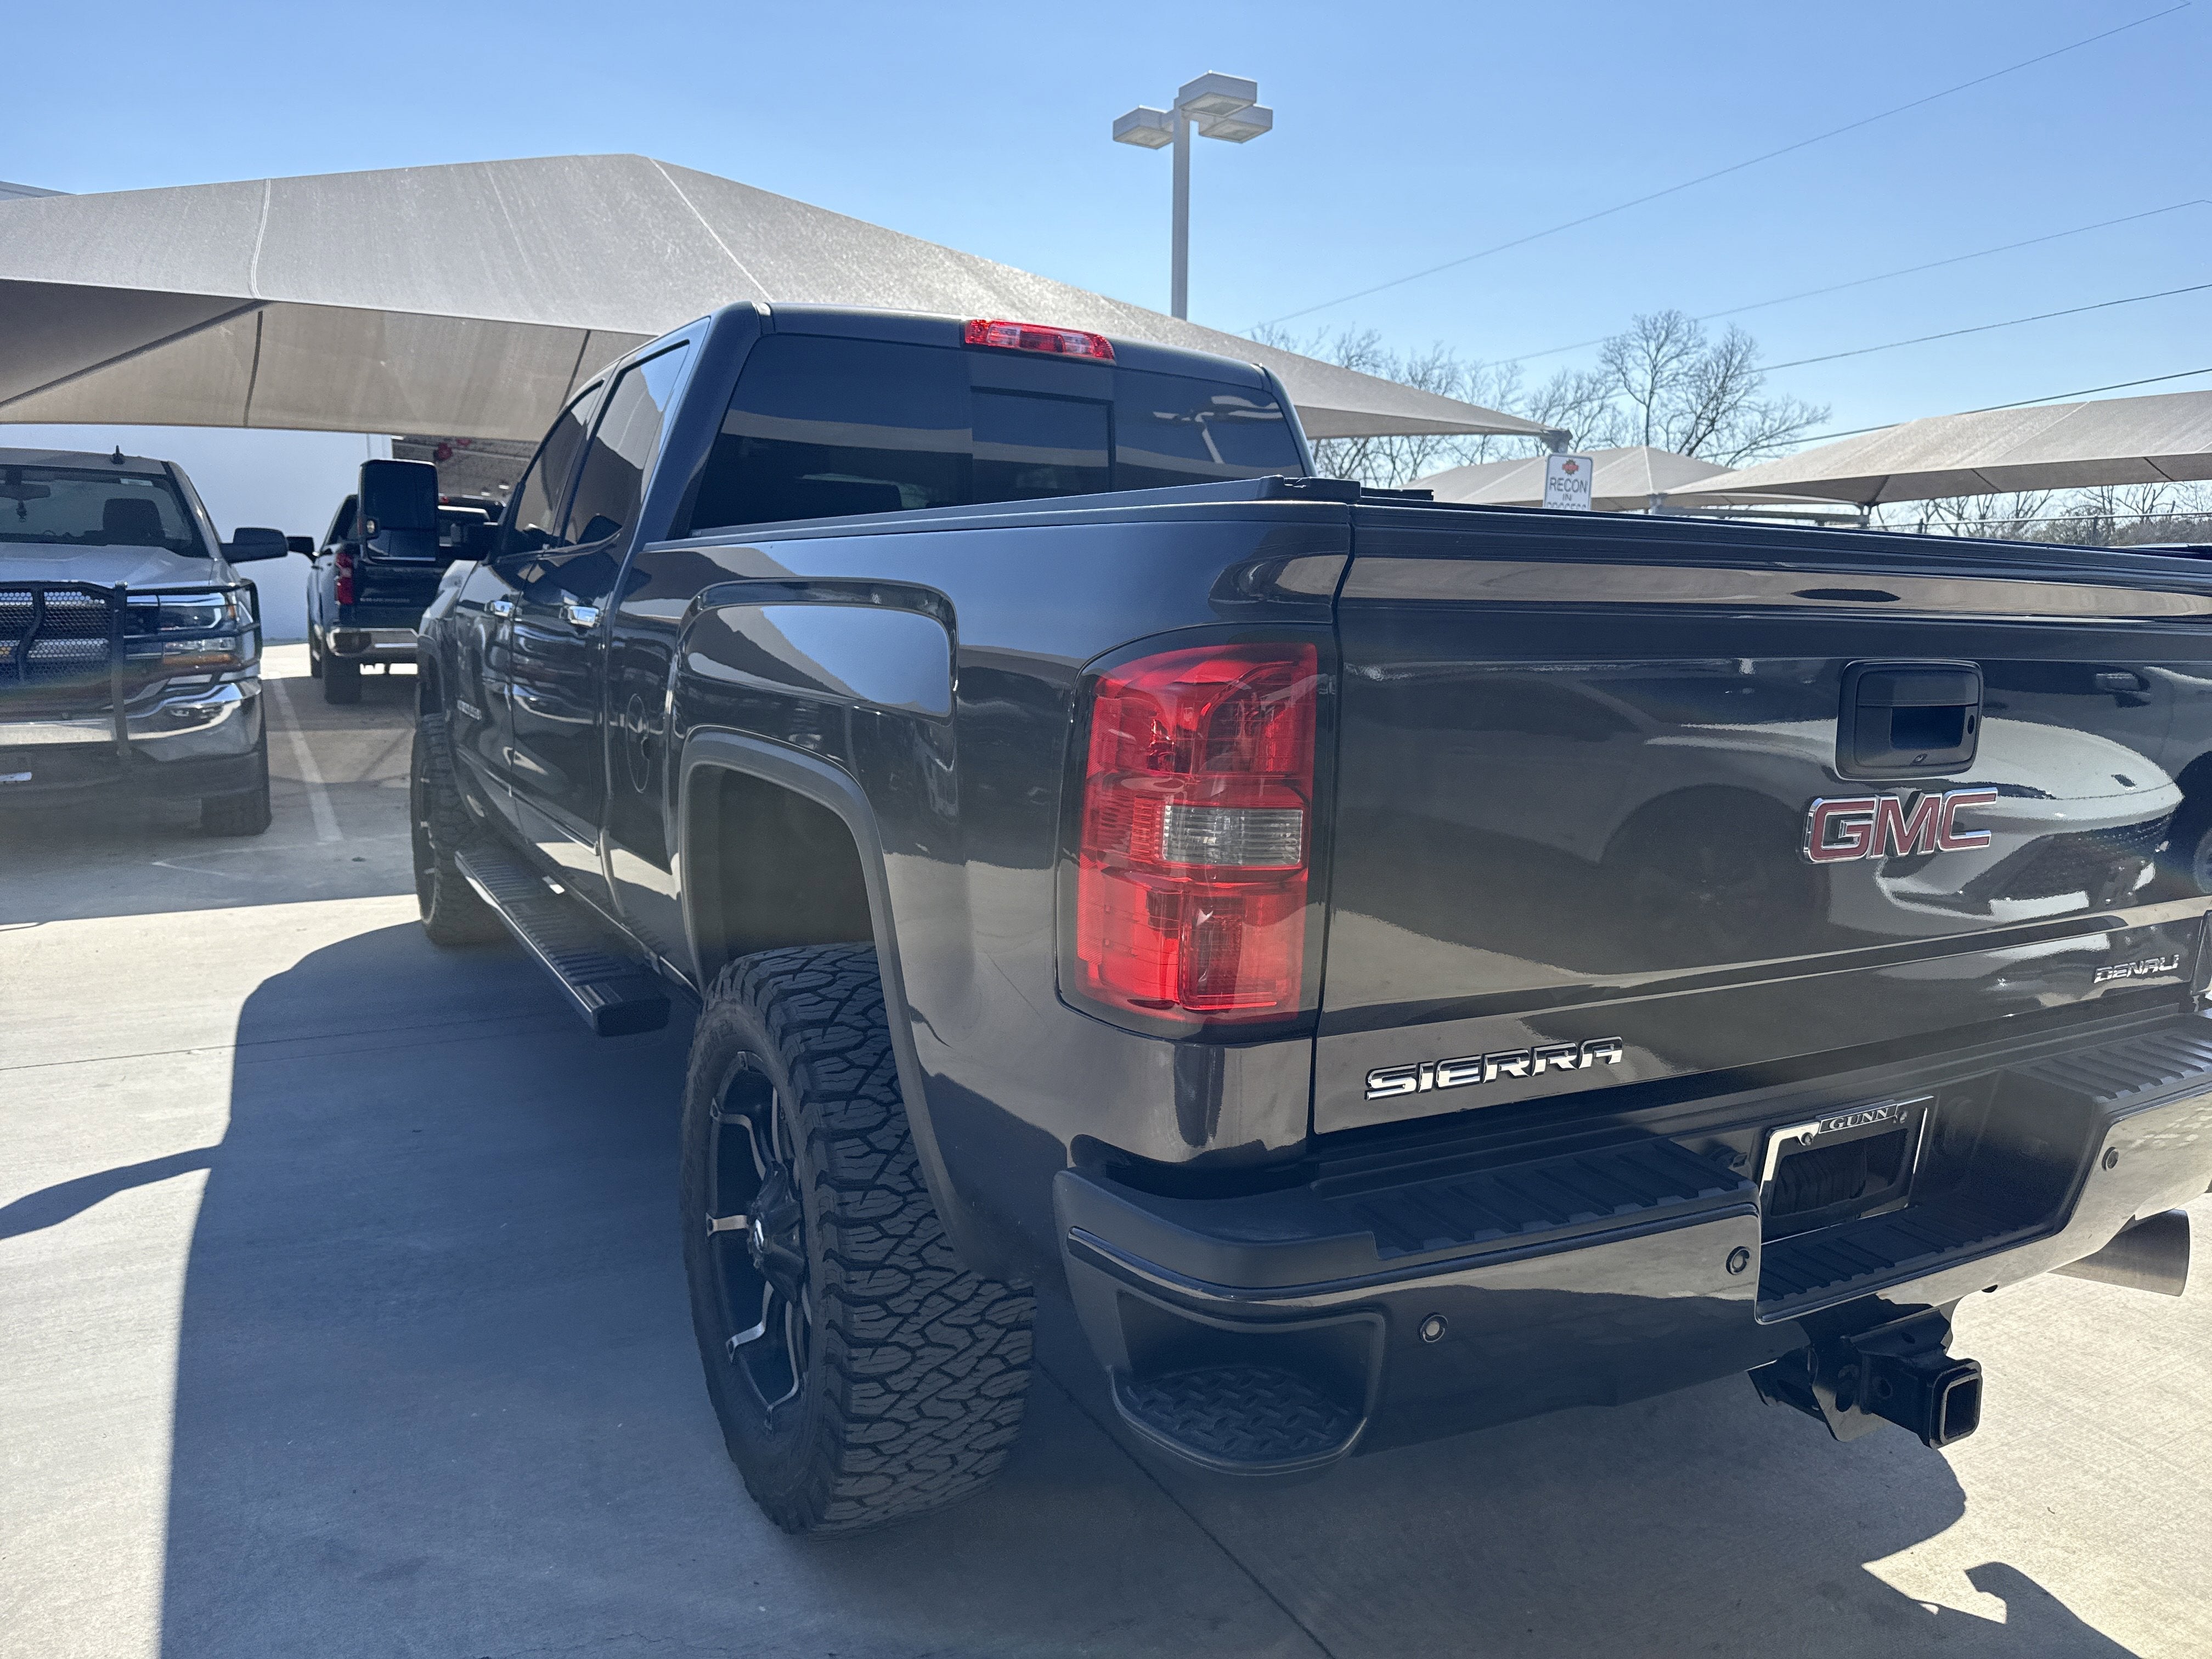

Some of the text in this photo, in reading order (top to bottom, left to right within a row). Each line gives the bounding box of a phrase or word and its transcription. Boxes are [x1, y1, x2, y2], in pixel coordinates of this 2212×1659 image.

[1549, 477, 1588, 493] RECON
[1562, 493, 1572, 501] IN
[1803, 787, 1999, 864] GMC
[2094, 954, 2180, 984] DENALI
[1364, 1036, 1623, 1101] SIERRA
[1829, 1108, 1889, 1129] GUNN
